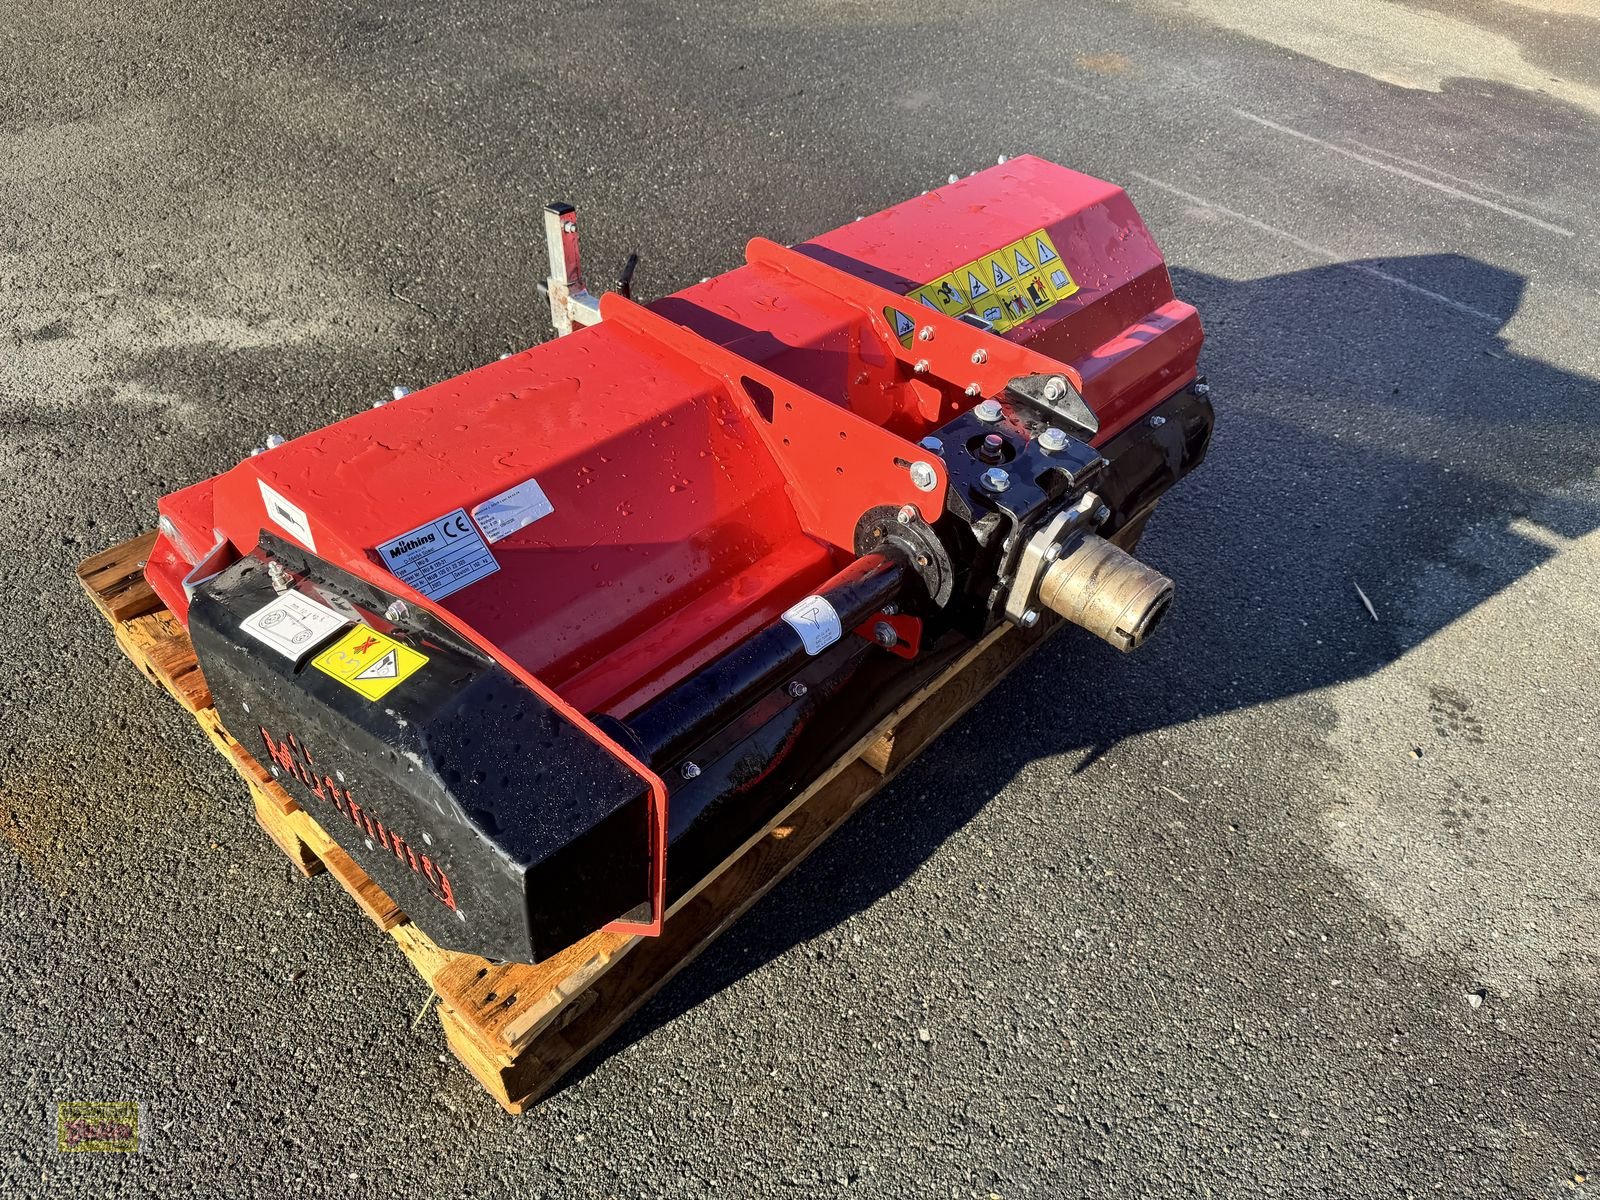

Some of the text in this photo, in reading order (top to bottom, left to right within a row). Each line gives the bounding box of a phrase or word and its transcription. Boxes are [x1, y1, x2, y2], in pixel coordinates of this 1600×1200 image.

[443, 516, 470, 538] CE
[390, 533, 436, 559] Müthing
[257, 723, 457, 912] Müthing
